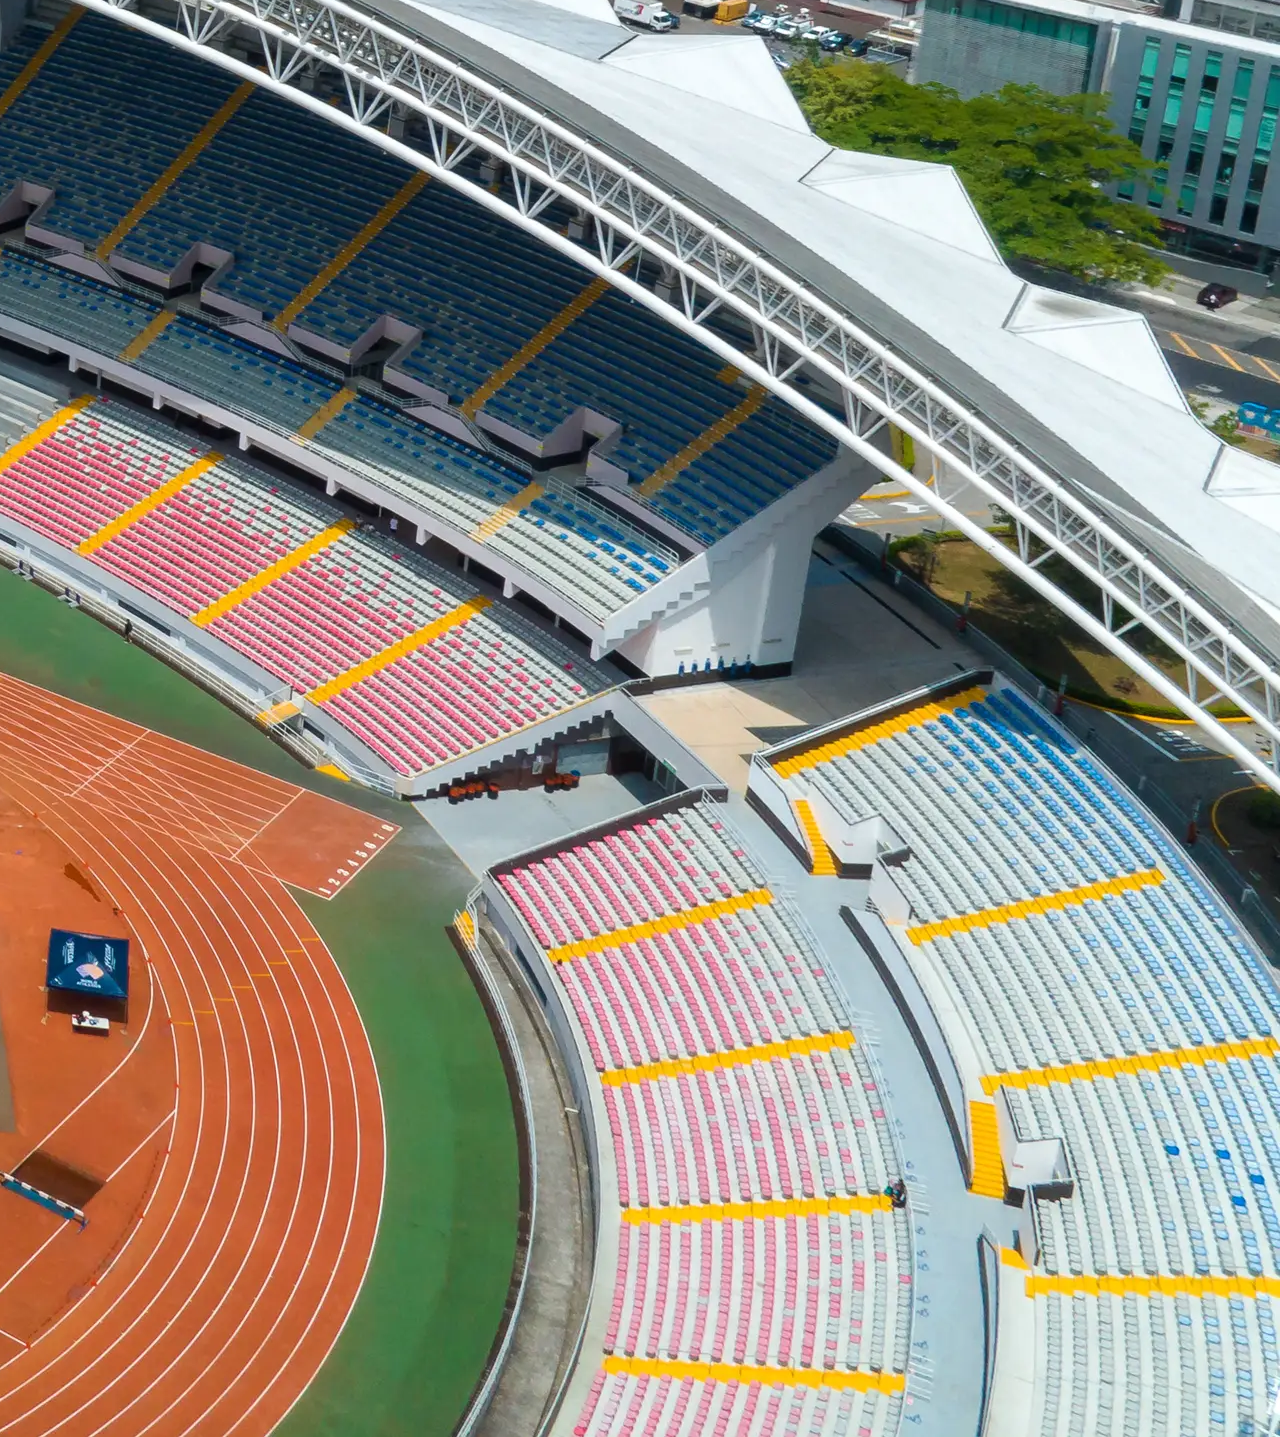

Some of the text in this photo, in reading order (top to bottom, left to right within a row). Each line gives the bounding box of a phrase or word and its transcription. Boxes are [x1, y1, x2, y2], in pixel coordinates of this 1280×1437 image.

[328, 877, 340, 886] 2
[336, 868, 349, 876] 3
[347, 859, 359, 867] 4
[355, 850, 368, 858] 5
[364, 841, 377, 849] 6
[381, 824, 394, 832] 8
